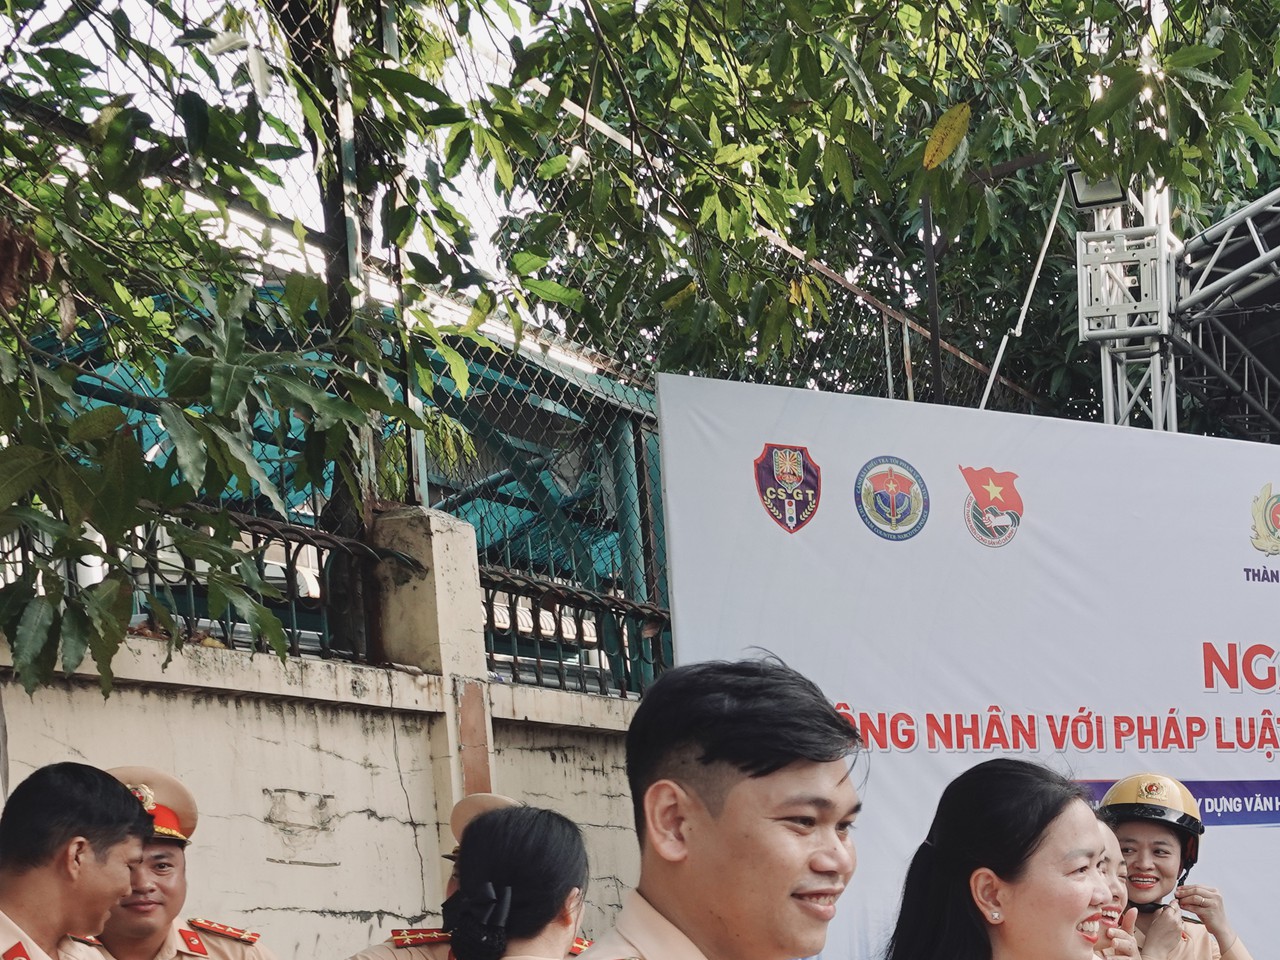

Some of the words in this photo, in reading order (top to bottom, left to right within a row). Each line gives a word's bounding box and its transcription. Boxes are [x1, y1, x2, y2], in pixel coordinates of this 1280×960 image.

[926, 705, 1037, 750] NHÂN
[1047, 707, 1104, 749] VỚI
[1115, 707, 1208, 750] PHÁP
[1205, 796, 1242, 818] DỰNG
[1245, 793, 1274, 812] VĂN
